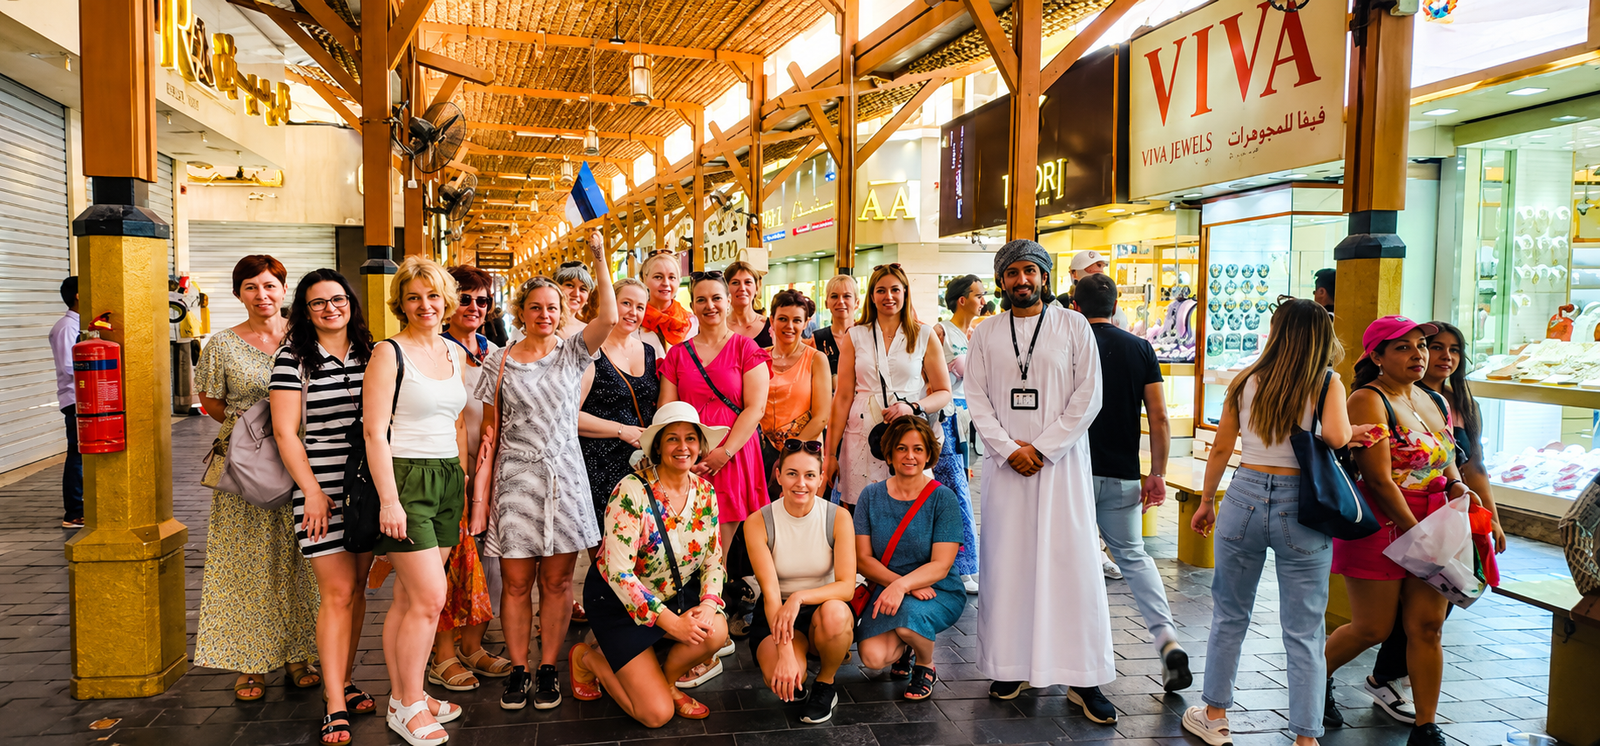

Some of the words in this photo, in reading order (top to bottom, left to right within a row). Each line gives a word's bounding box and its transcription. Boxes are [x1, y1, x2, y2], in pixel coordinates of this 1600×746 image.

[1144, 0, 1322, 127] VIVA
[1228, 112, 1294, 148] للمجوهرات
[1297, 105, 1326, 131] فيفا
[1141, 145, 1168, 167] VIVA
[1169, 132, 1213, 164] JEWELS
